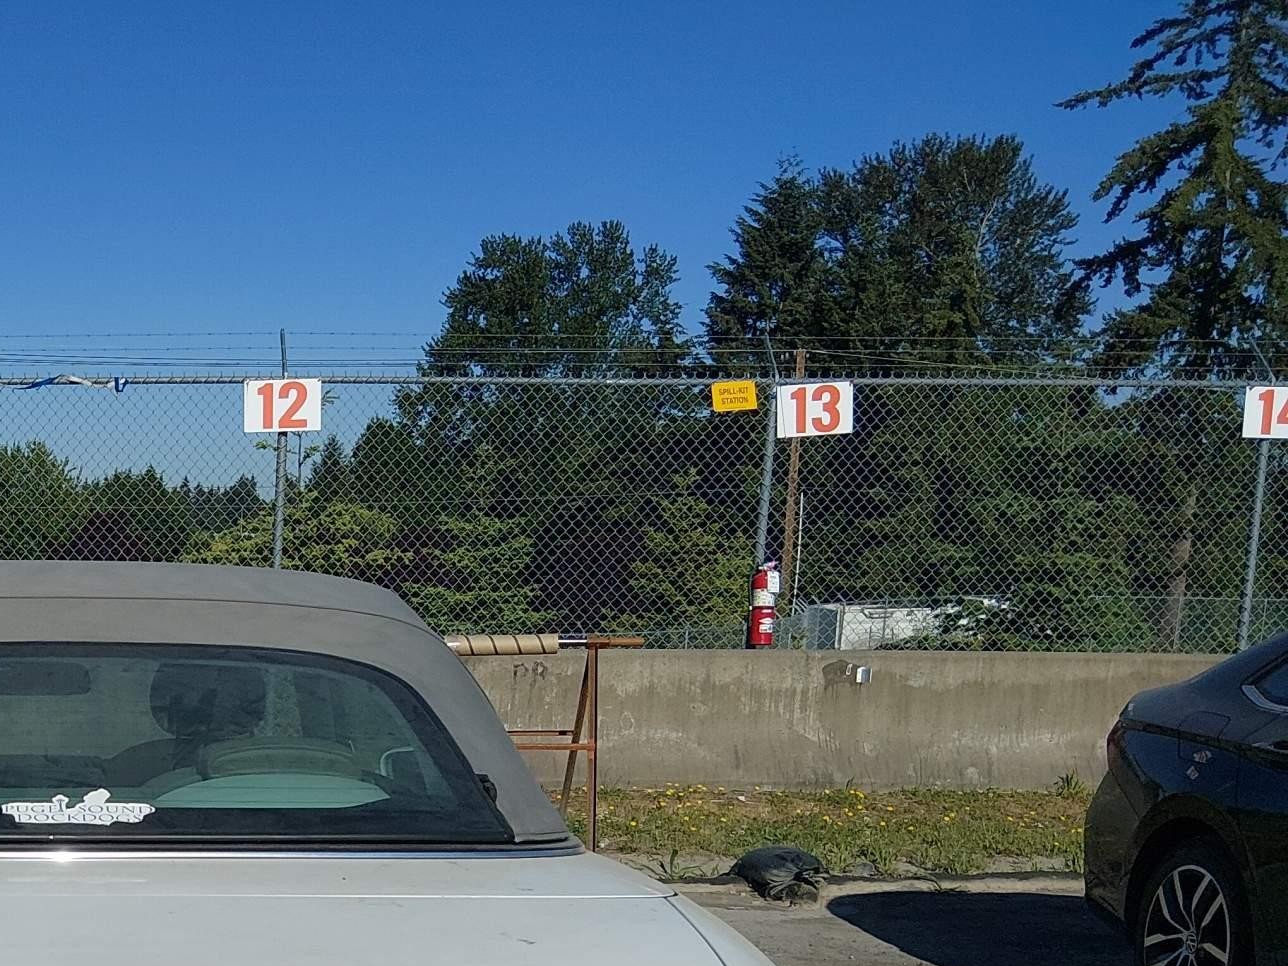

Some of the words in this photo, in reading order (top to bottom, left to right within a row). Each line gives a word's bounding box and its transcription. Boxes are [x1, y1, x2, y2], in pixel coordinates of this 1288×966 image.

[257, 382, 307, 429] 12
[721, 396, 748, 405] STATION
[791, 385, 841, 433] 13
[78, 804, 154, 814] SOUND
